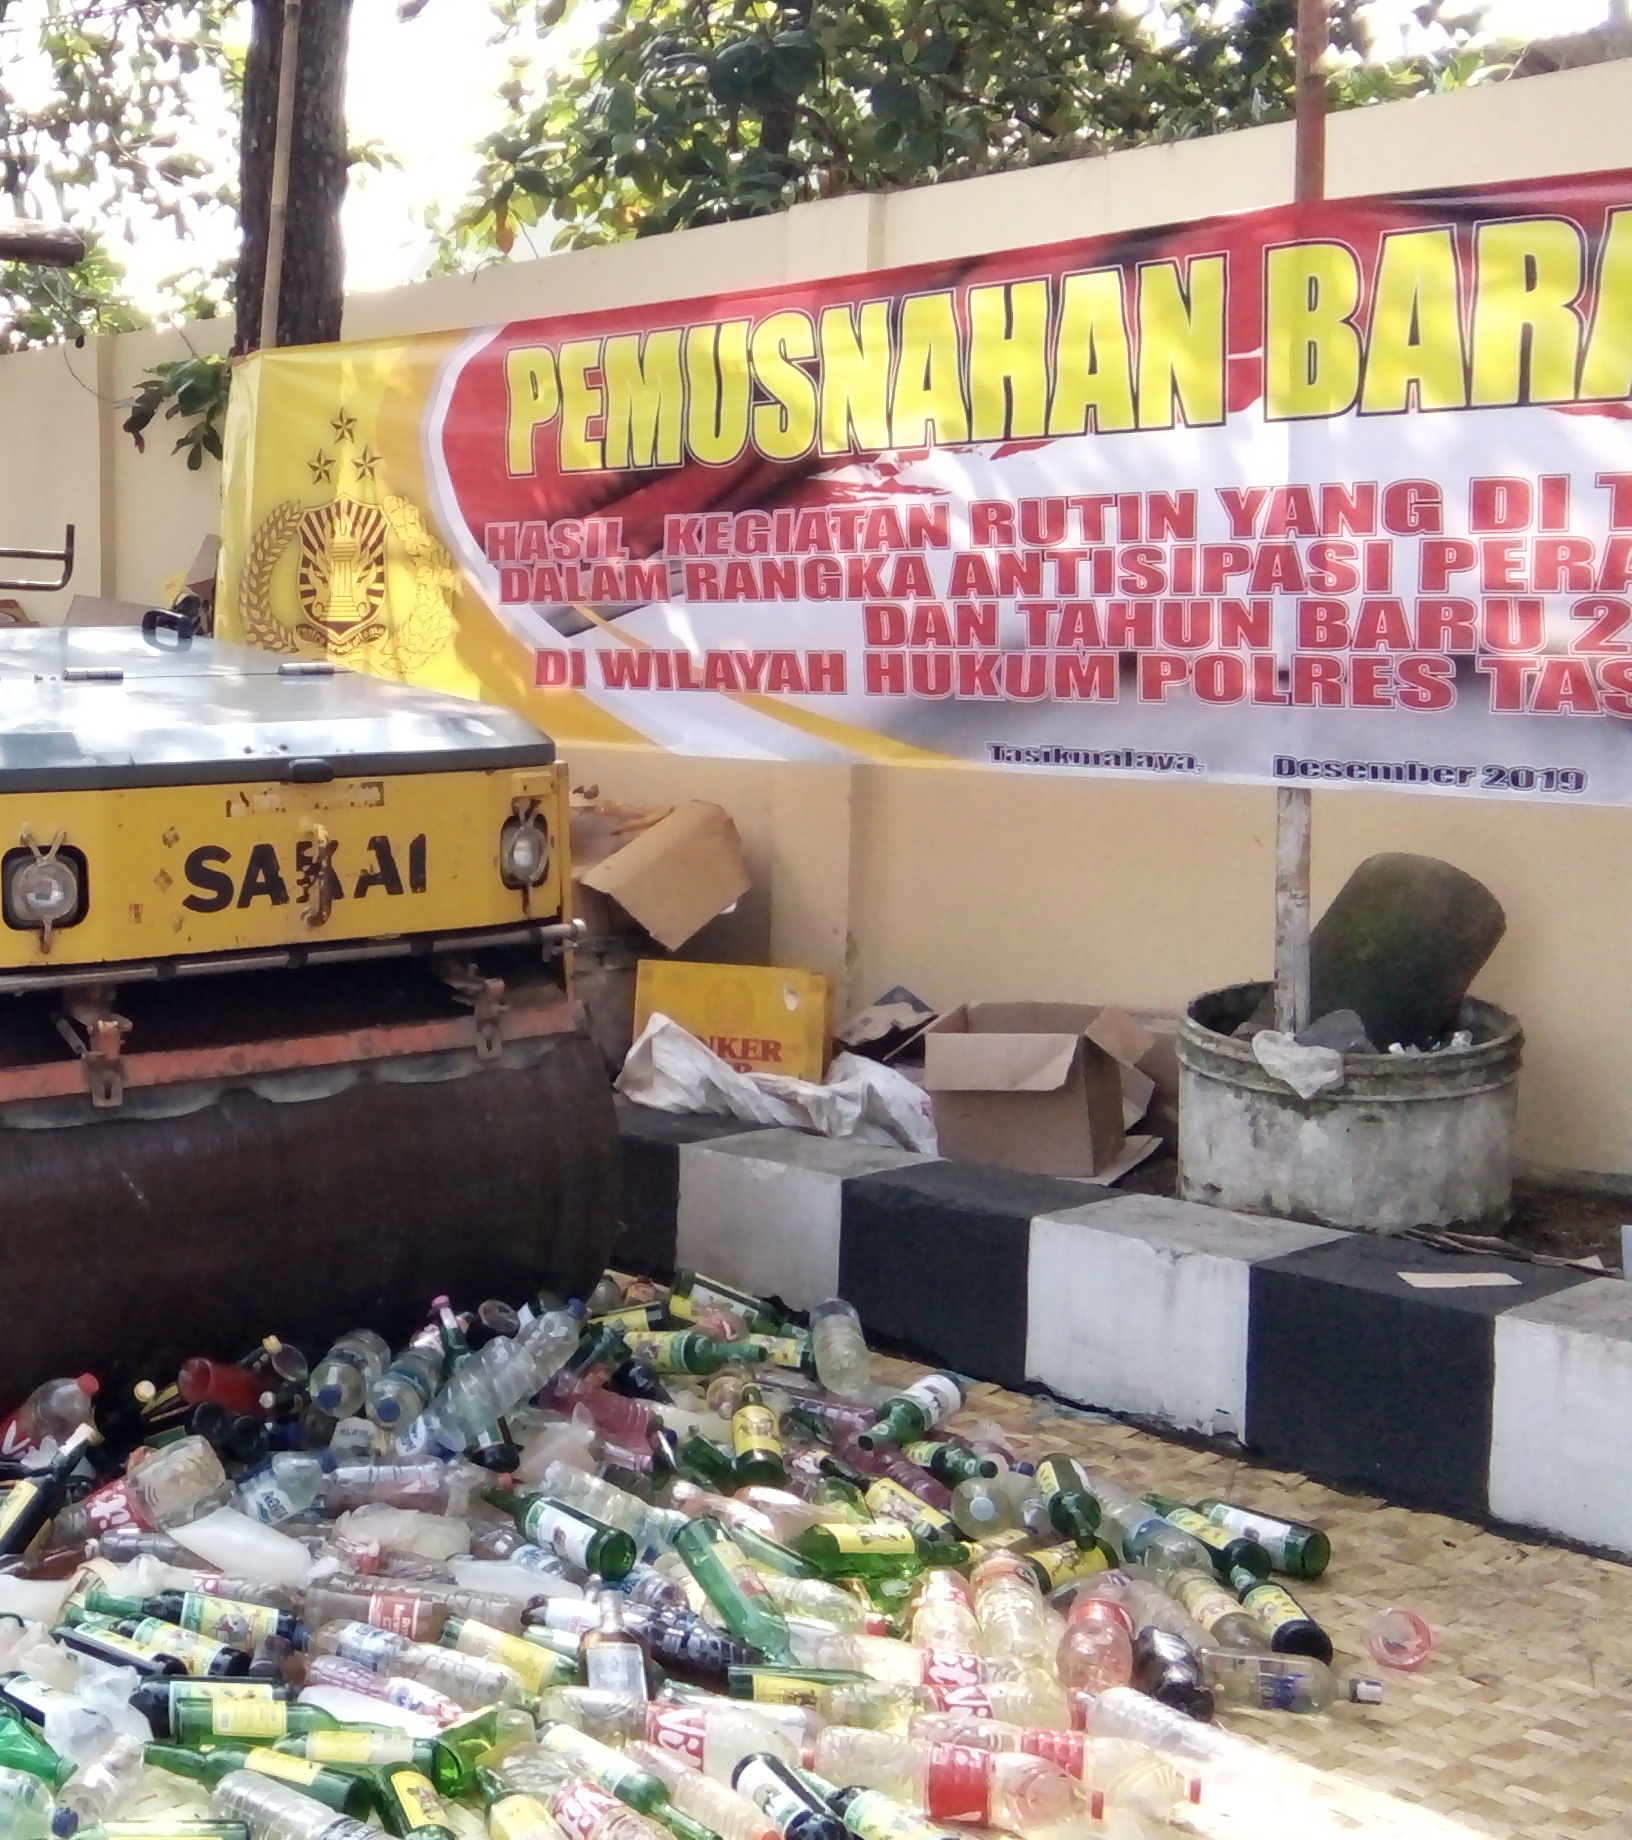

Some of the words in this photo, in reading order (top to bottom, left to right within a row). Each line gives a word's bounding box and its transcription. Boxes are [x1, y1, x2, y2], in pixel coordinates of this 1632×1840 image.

[505, 250, 1230, 478] PEMUSNAHAN
[484, 516, 630, 564] HASIL
[663, 502, 951, 558] KEGIATAN
[969, 490, 1199, 549] RUTIN
[1215, 478, 1444, 540] YANG
[1469, 472, 1571, 535] DI
[498, 561, 672, 605] DALAM
[684, 553, 936, 604] RANGKA
[947, 538, 1394, 599] ANTISIPASI
[862, 600, 1000, 650] DAN
[1015, 598, 1273, 651] TAHUN
[1296, 596, 1548, 655] BARU
[534, 647, 587, 690] DI
[596, 648, 848, 696] WILAYAH
[863, 650, 1121, 703] HUKUM
[1135, 651, 1458, 714] POLRES
[986, 742, 1206, 775] Tasikmalaya,
[1272, 755, 1475, 789] Desember
[1481, 764, 1588, 794] 2019
[182, 834, 427, 913] SAKAI
